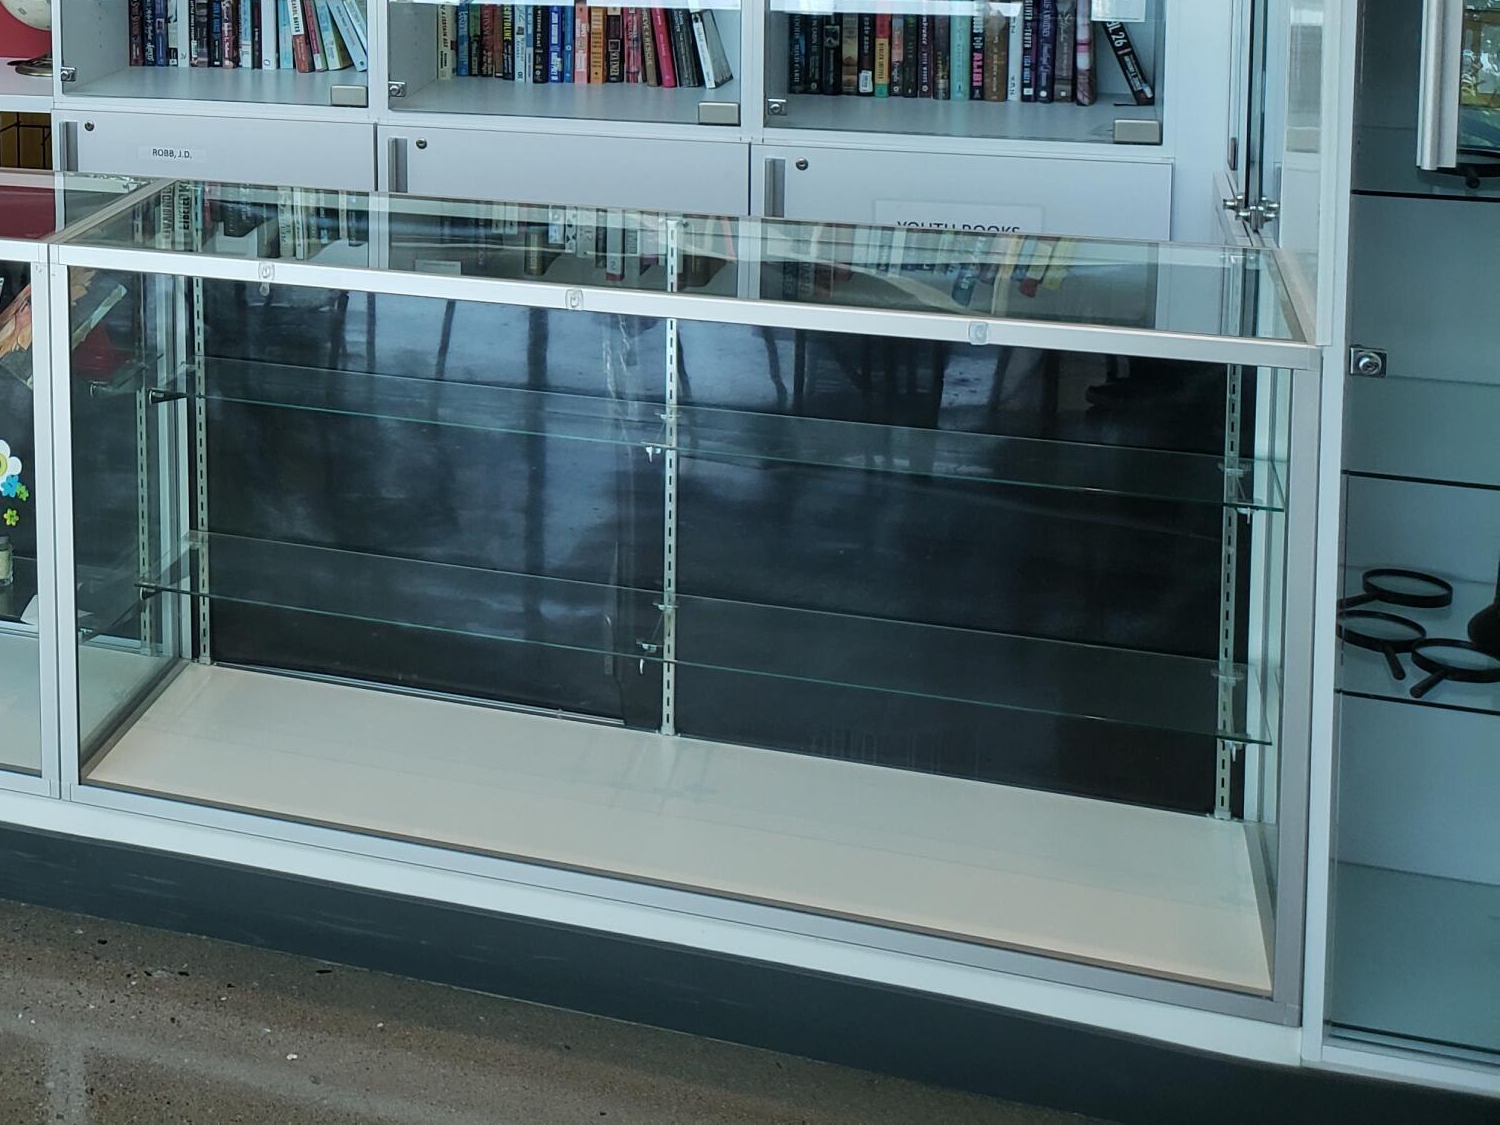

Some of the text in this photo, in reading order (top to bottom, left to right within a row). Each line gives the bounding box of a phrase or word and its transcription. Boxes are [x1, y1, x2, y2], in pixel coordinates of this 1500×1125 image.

[641, 9, 652, 66] HREVE RESCUE
[1110, 32, 1125, 47] 26
[972, 52, 983, 87] ALIBI
[152, 148, 193, 159] ROBB, J.D.
